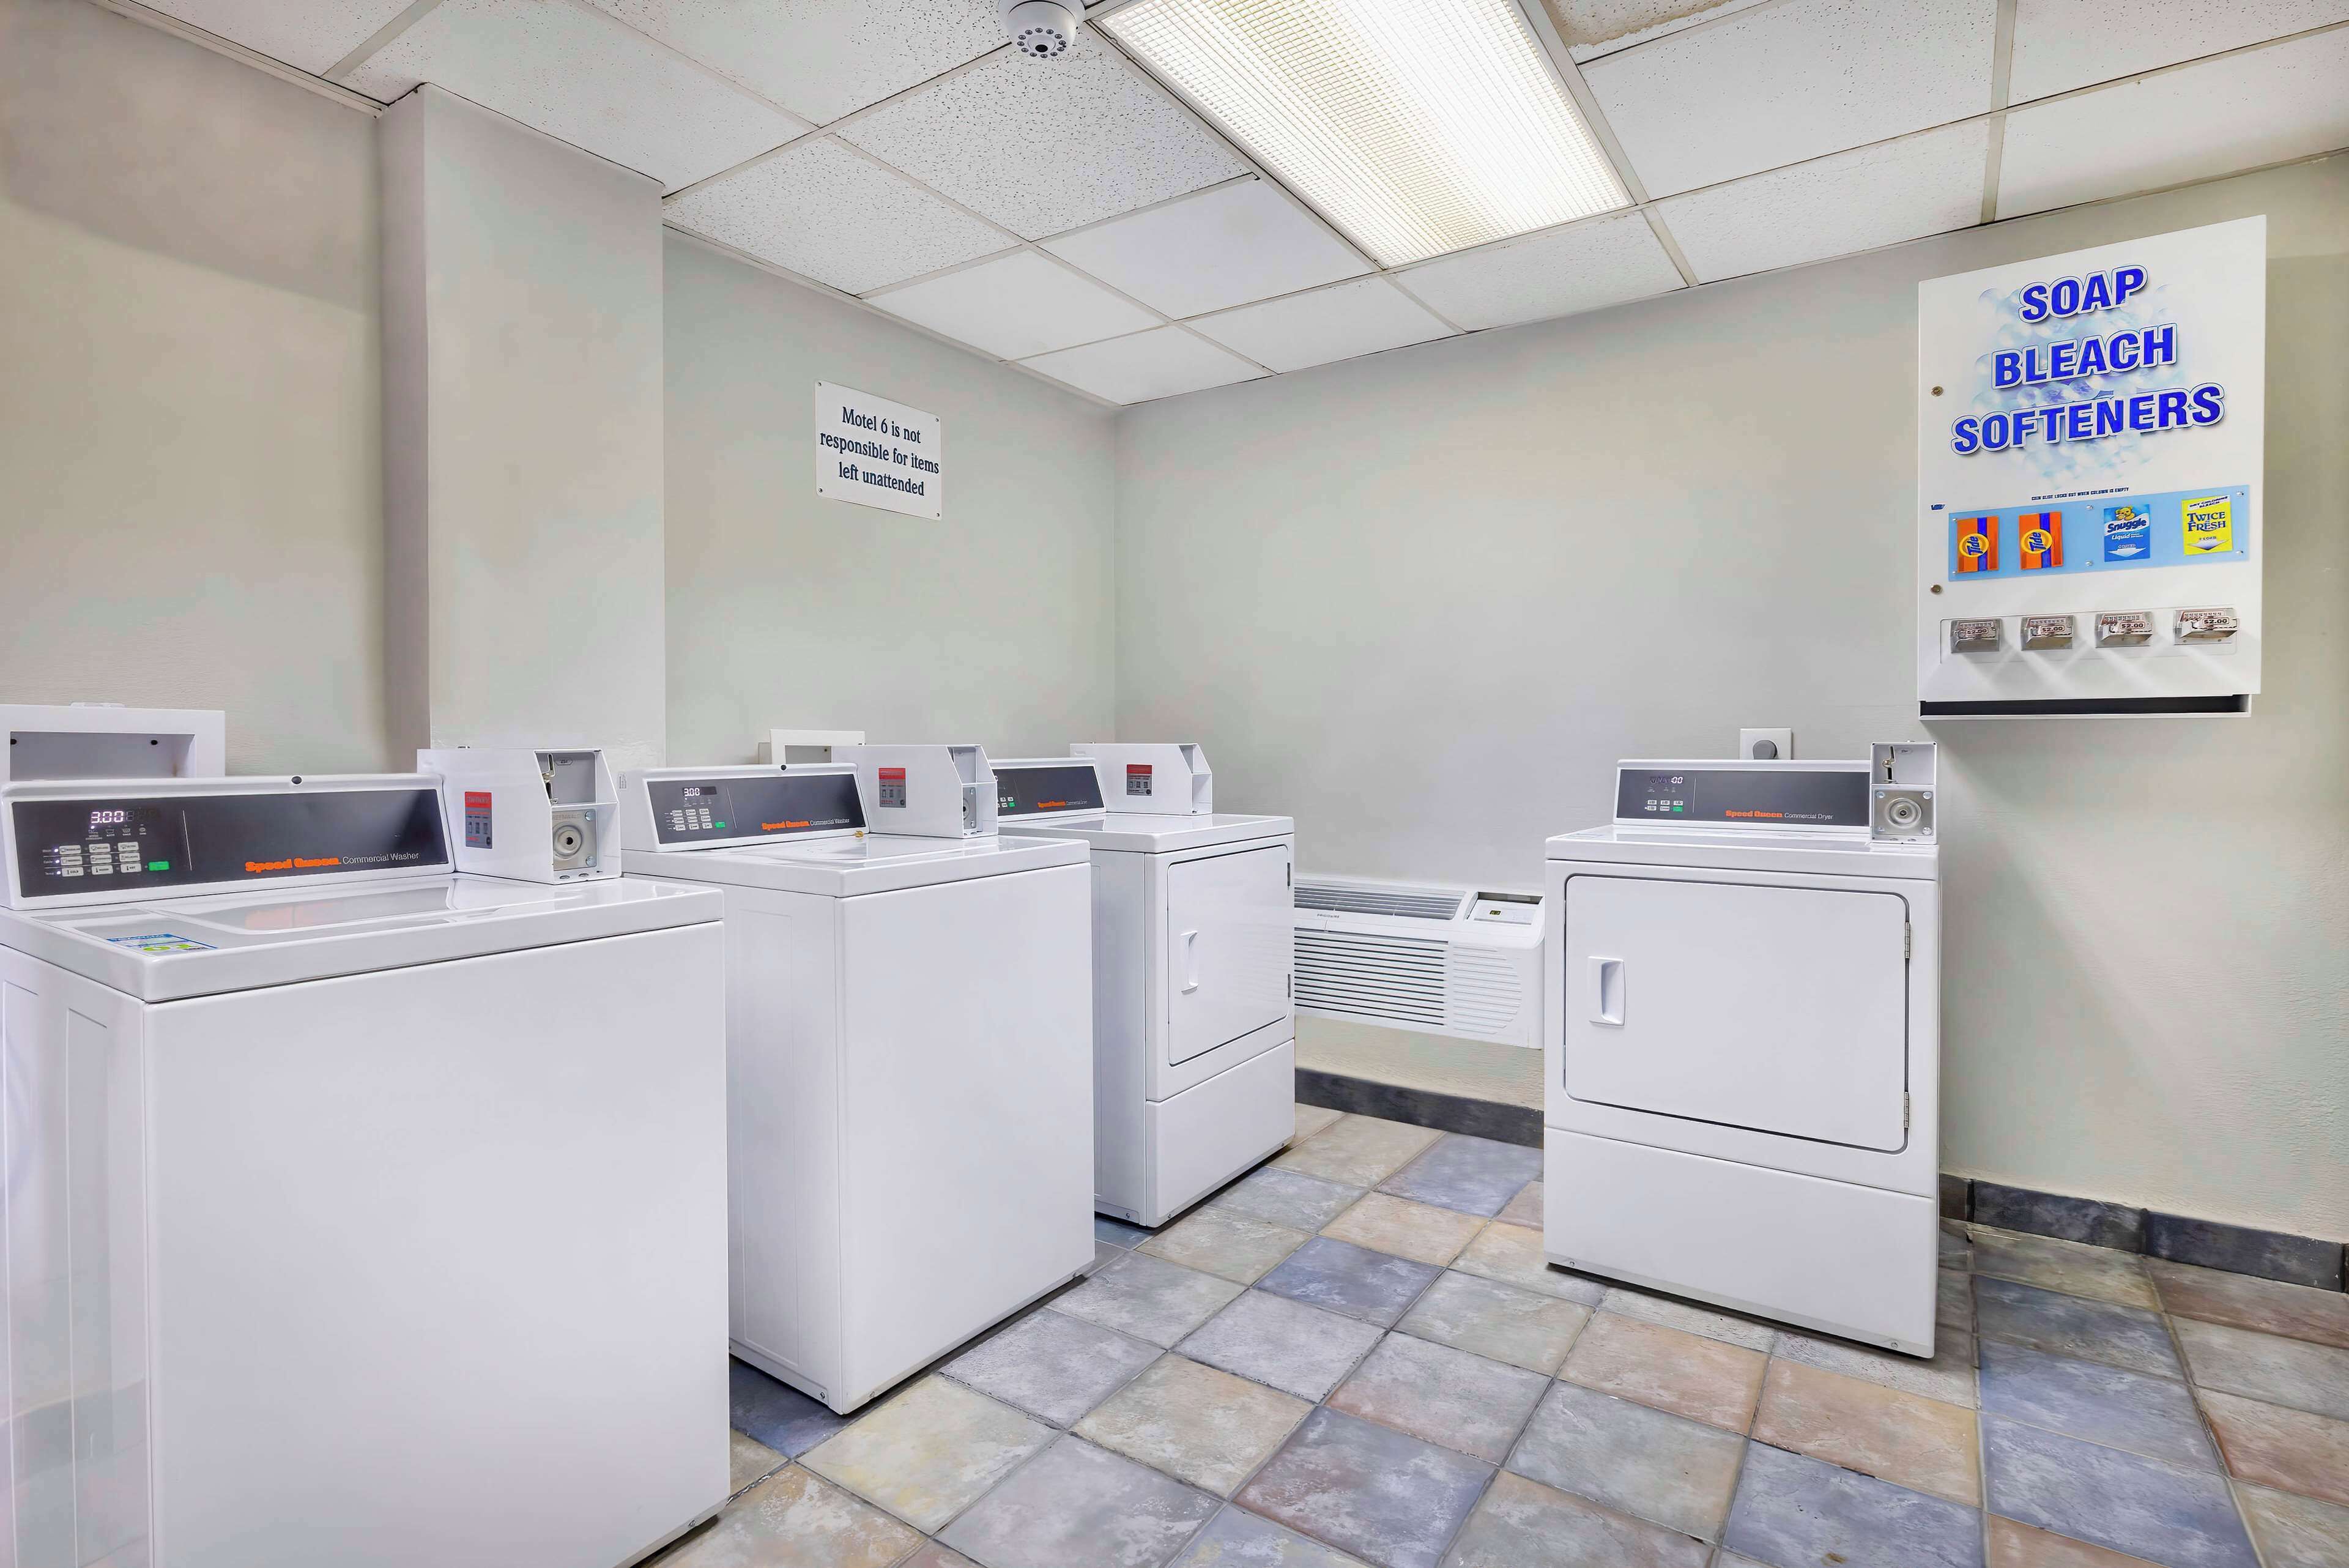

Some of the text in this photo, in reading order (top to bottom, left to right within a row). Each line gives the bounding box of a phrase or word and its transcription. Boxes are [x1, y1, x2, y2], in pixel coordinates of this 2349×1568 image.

[2021, 266, 2146, 322] SOAP
[1994, 324, 2176, 388] BLEACH
[842, 406, 921, 444] Motel 6 is not
[1952, 384, 2224, 454] SOFTENERS
[820, 432, 939, 474] responsible for items
[839, 461, 924, 496] left unattended
[2107, 518, 2147, 533] Snuggle
[2187, 511, 2225, 522] TWICE
[2188, 521, 2226, 532] FRESH
[1967, 536, 1984, 555] Tide
[2029, 532, 2047, 552] Tide
[684, 787, 700, 797] 3.00
[91, 811, 124, 823] 3.00
[245, 858, 292, 873] Speed
[343, 853, 389, 864] Commercial
[390, 852, 419, 861] Washer
